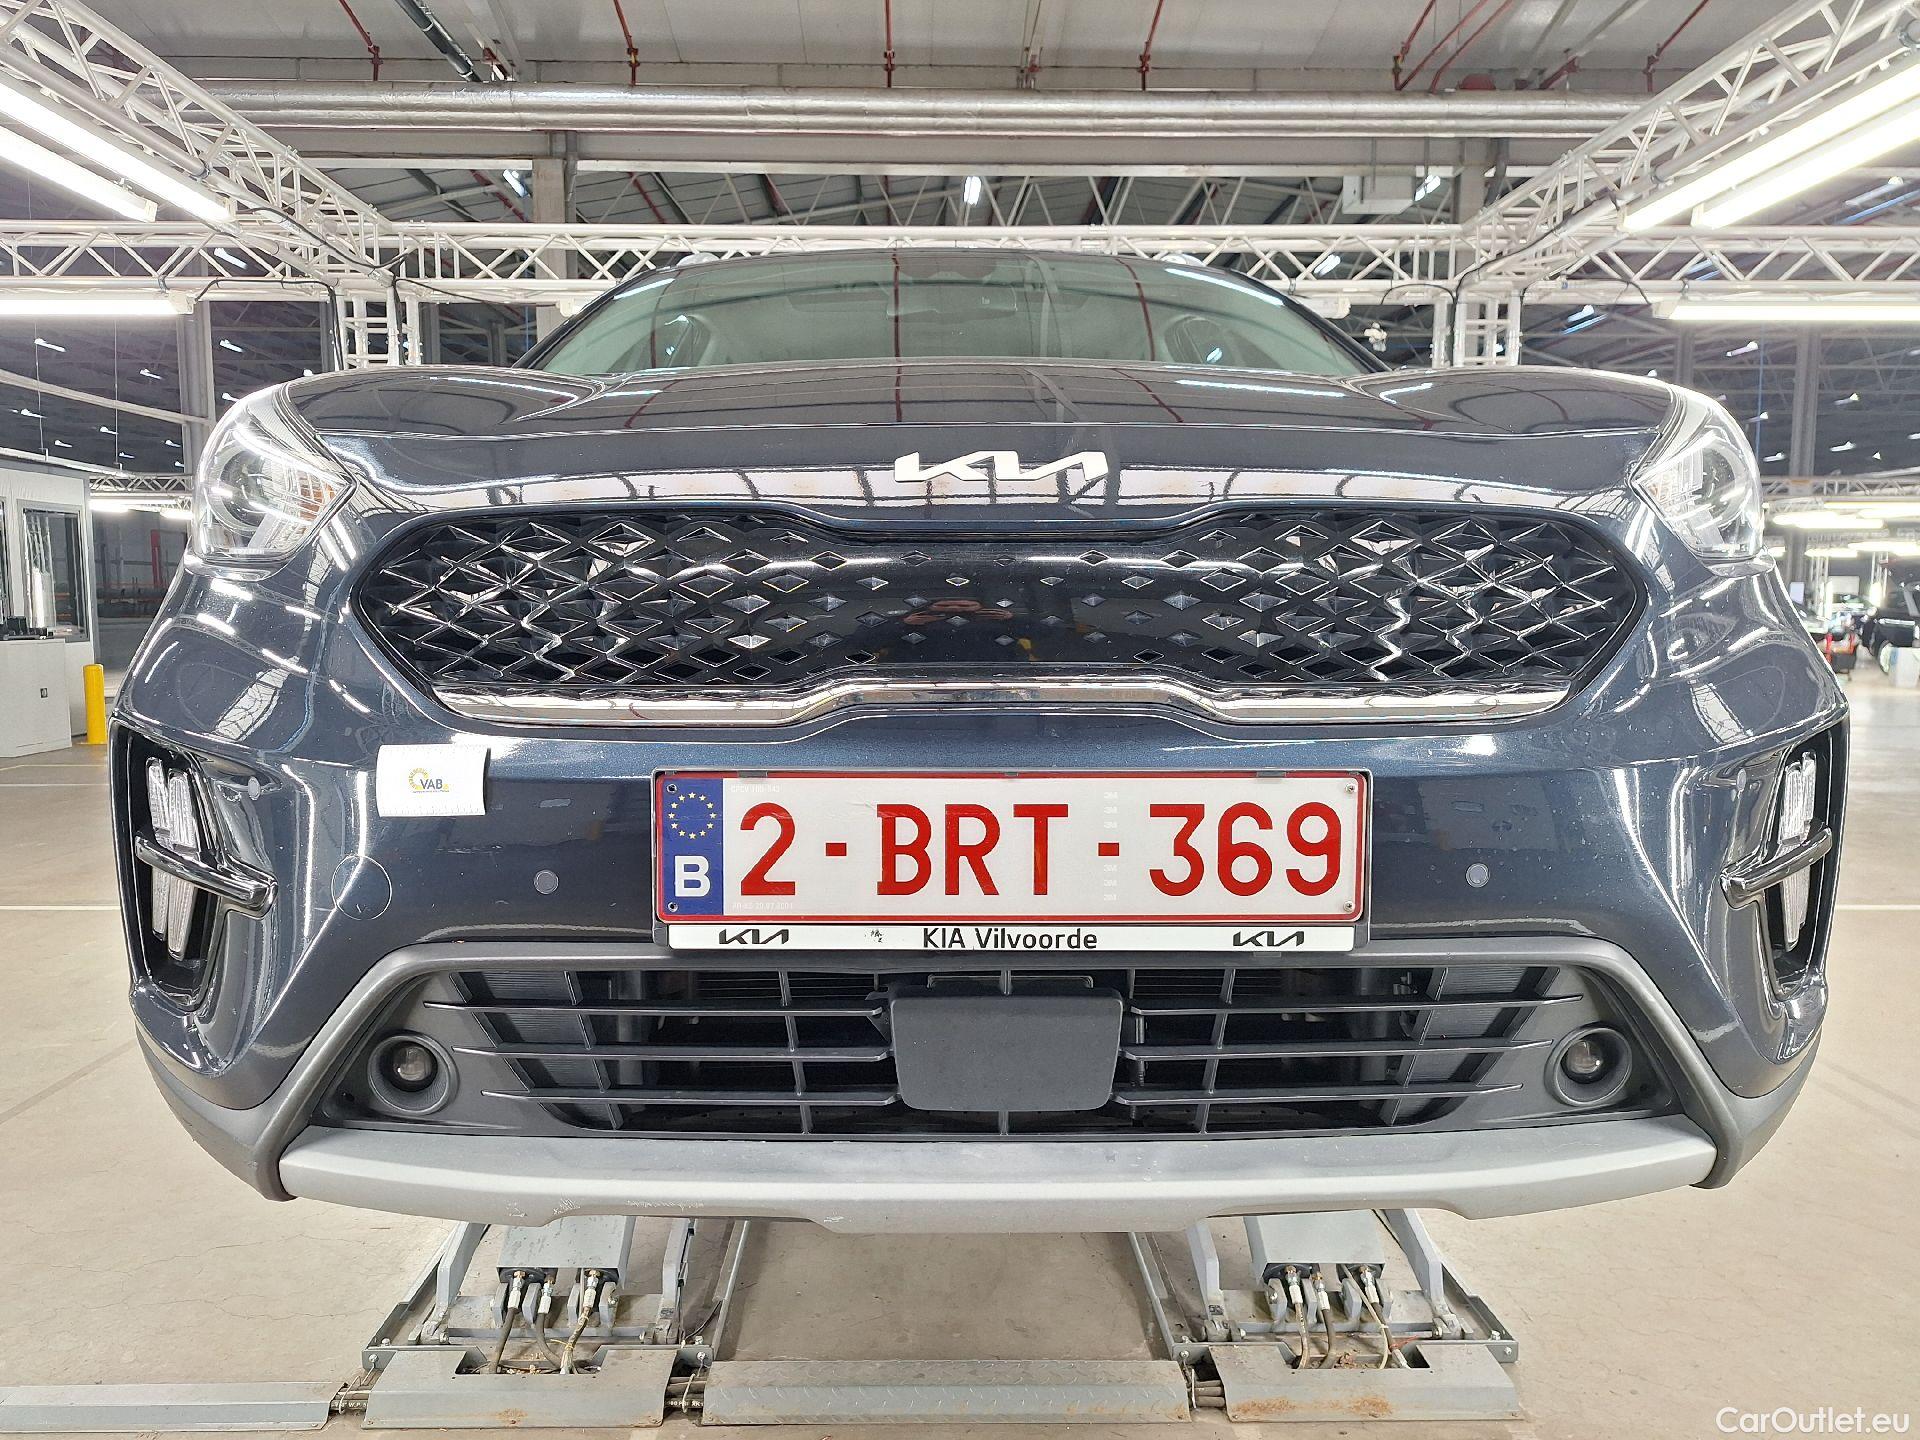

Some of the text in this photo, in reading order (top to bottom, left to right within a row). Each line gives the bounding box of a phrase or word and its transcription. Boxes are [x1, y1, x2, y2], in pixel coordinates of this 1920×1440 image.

[420, 778, 443, 790] VAB
[675, 856, 710, 897] B
[923, 927, 1098, 950] KIA Vilvoorde
